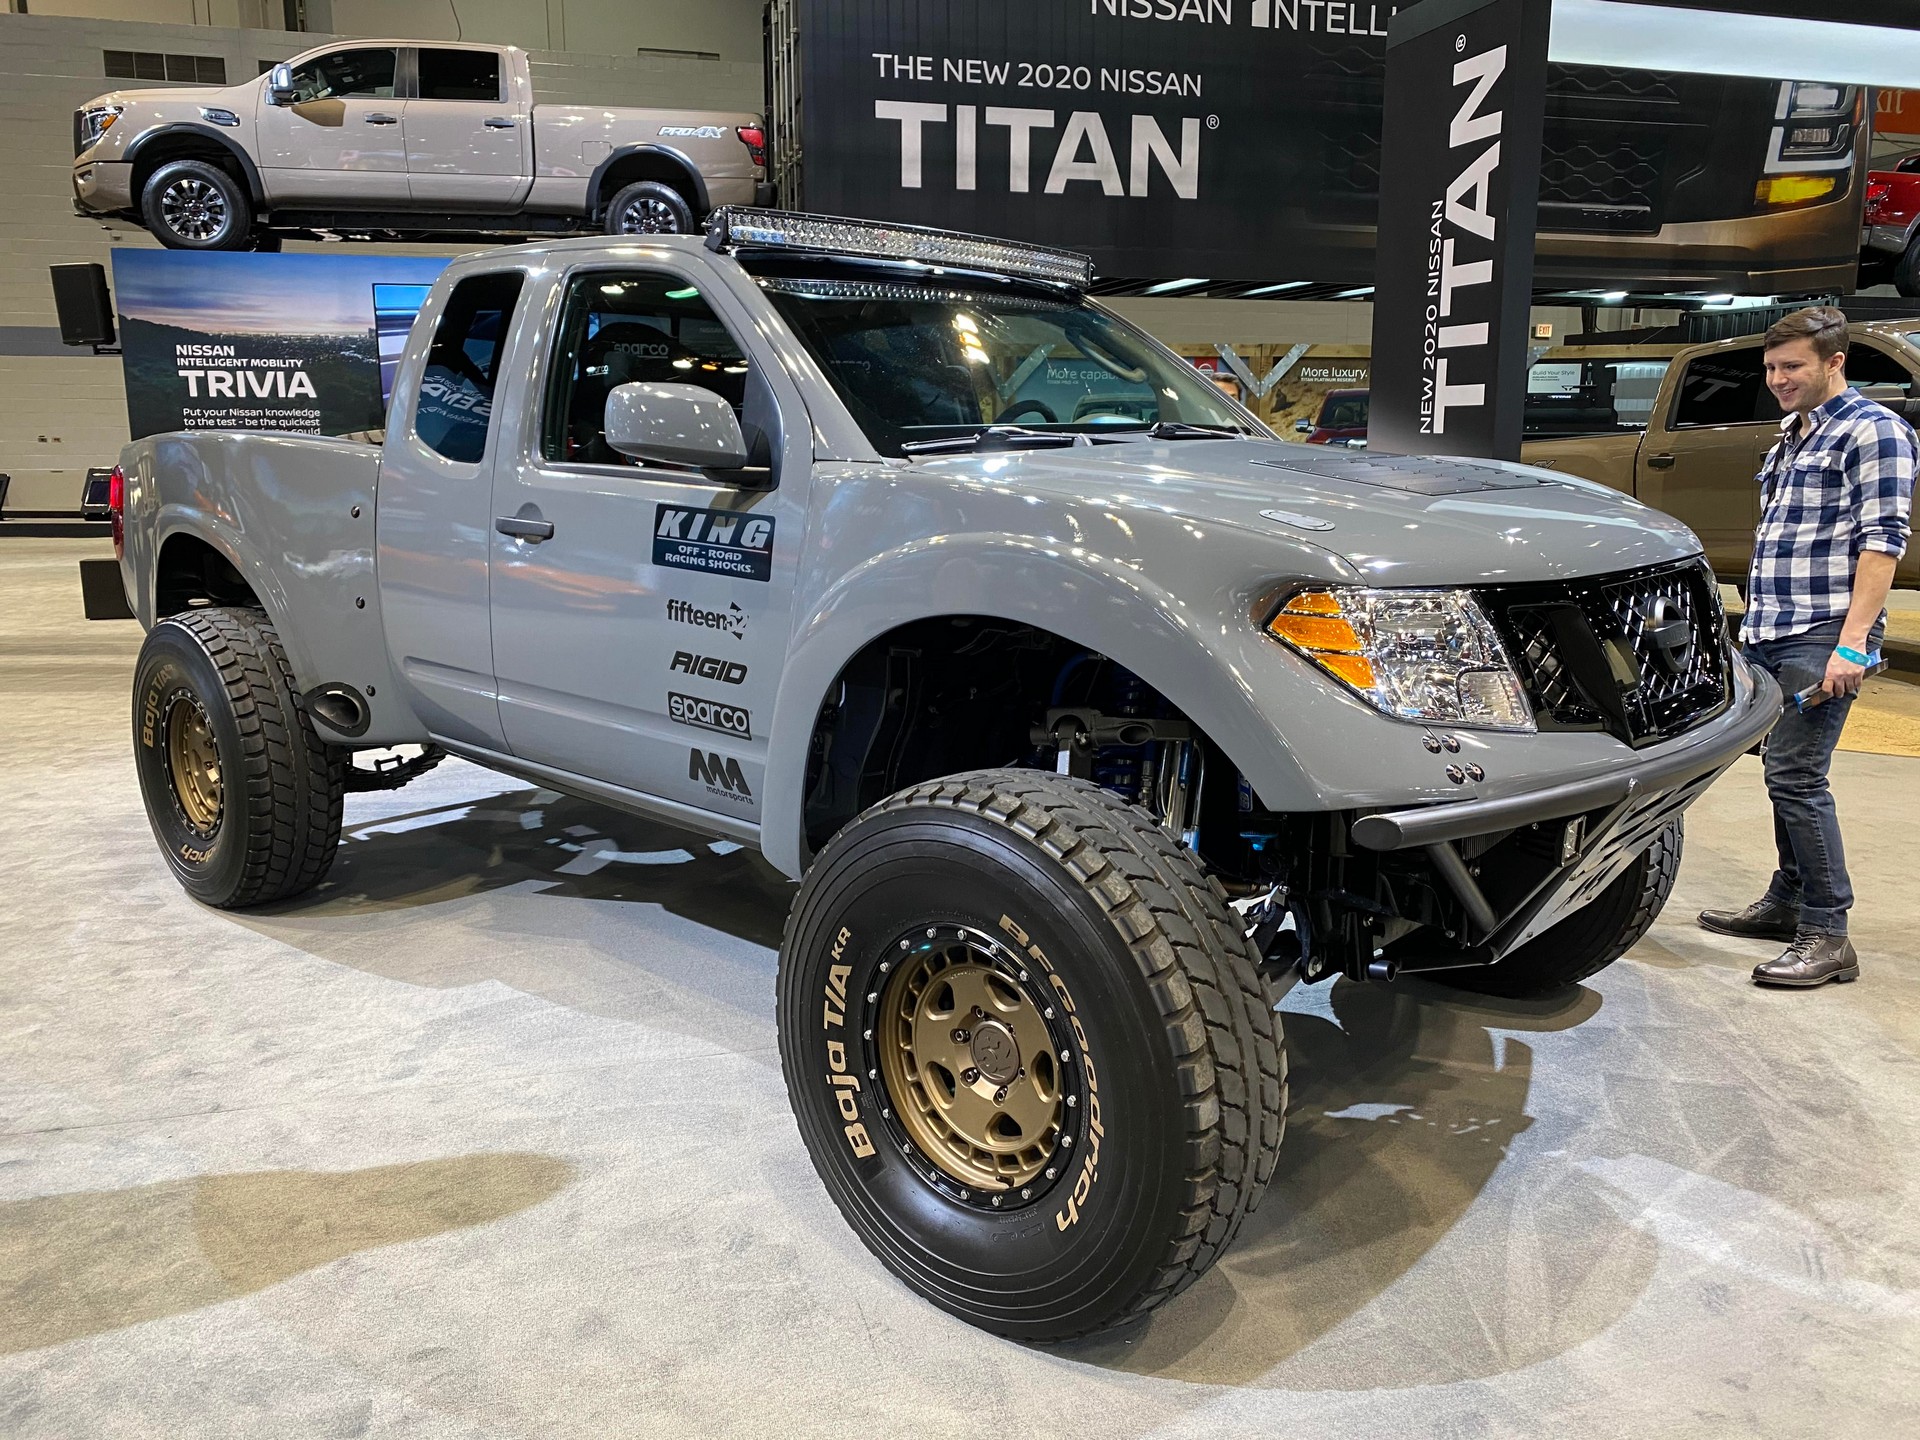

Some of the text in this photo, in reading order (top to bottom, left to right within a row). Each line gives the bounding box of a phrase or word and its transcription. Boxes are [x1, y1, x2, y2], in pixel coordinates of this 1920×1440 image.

[872, 53, 1201, 97] THE NEW 2020 NISSAN
[875, 100, 1200, 199] TITAN
[1433, 44, 1507, 434] TITAN
[1419, 200, 1444, 434] NEW 2020 NISSAN
[1538, 325, 1551, 335] EXIT
[176, 344, 235, 356] NISSAN
[177, 358, 303, 368] INTELLIGENT MOBILITY
[613, 343, 669, 357] sparco
[178, 370, 317, 398] TRIVIA
[1046, 368, 1077, 380] More
[1301, 367, 1368, 380] More luxury.
[183, 408, 321, 419] Put your Nissan knowledge
[184, 418, 195, 426] to
[197, 417, 214, 426] the
[216, 418, 236, 426] test
[245, 417, 258, 426] be
[260, 417, 276, 426] the
[278, 418, 321, 428] quickest
[657, 509, 771, 548] KING
[665, 552, 706, 566] RACING
[678, 545, 699, 555] OFF
[708, 549, 742, 561] ROAD
[669, 650, 748, 685] RIGID
[143, 691, 161, 748] Baja
[670, 695, 748, 732] sparco
[706, 785, 754, 805] motorsports
[830, 926, 851, 961] KR
[823, 964, 852, 1031] T/A
[998, 913, 1105, 1232] BFGoodrich
[826, 1040, 877, 1159] Baja
